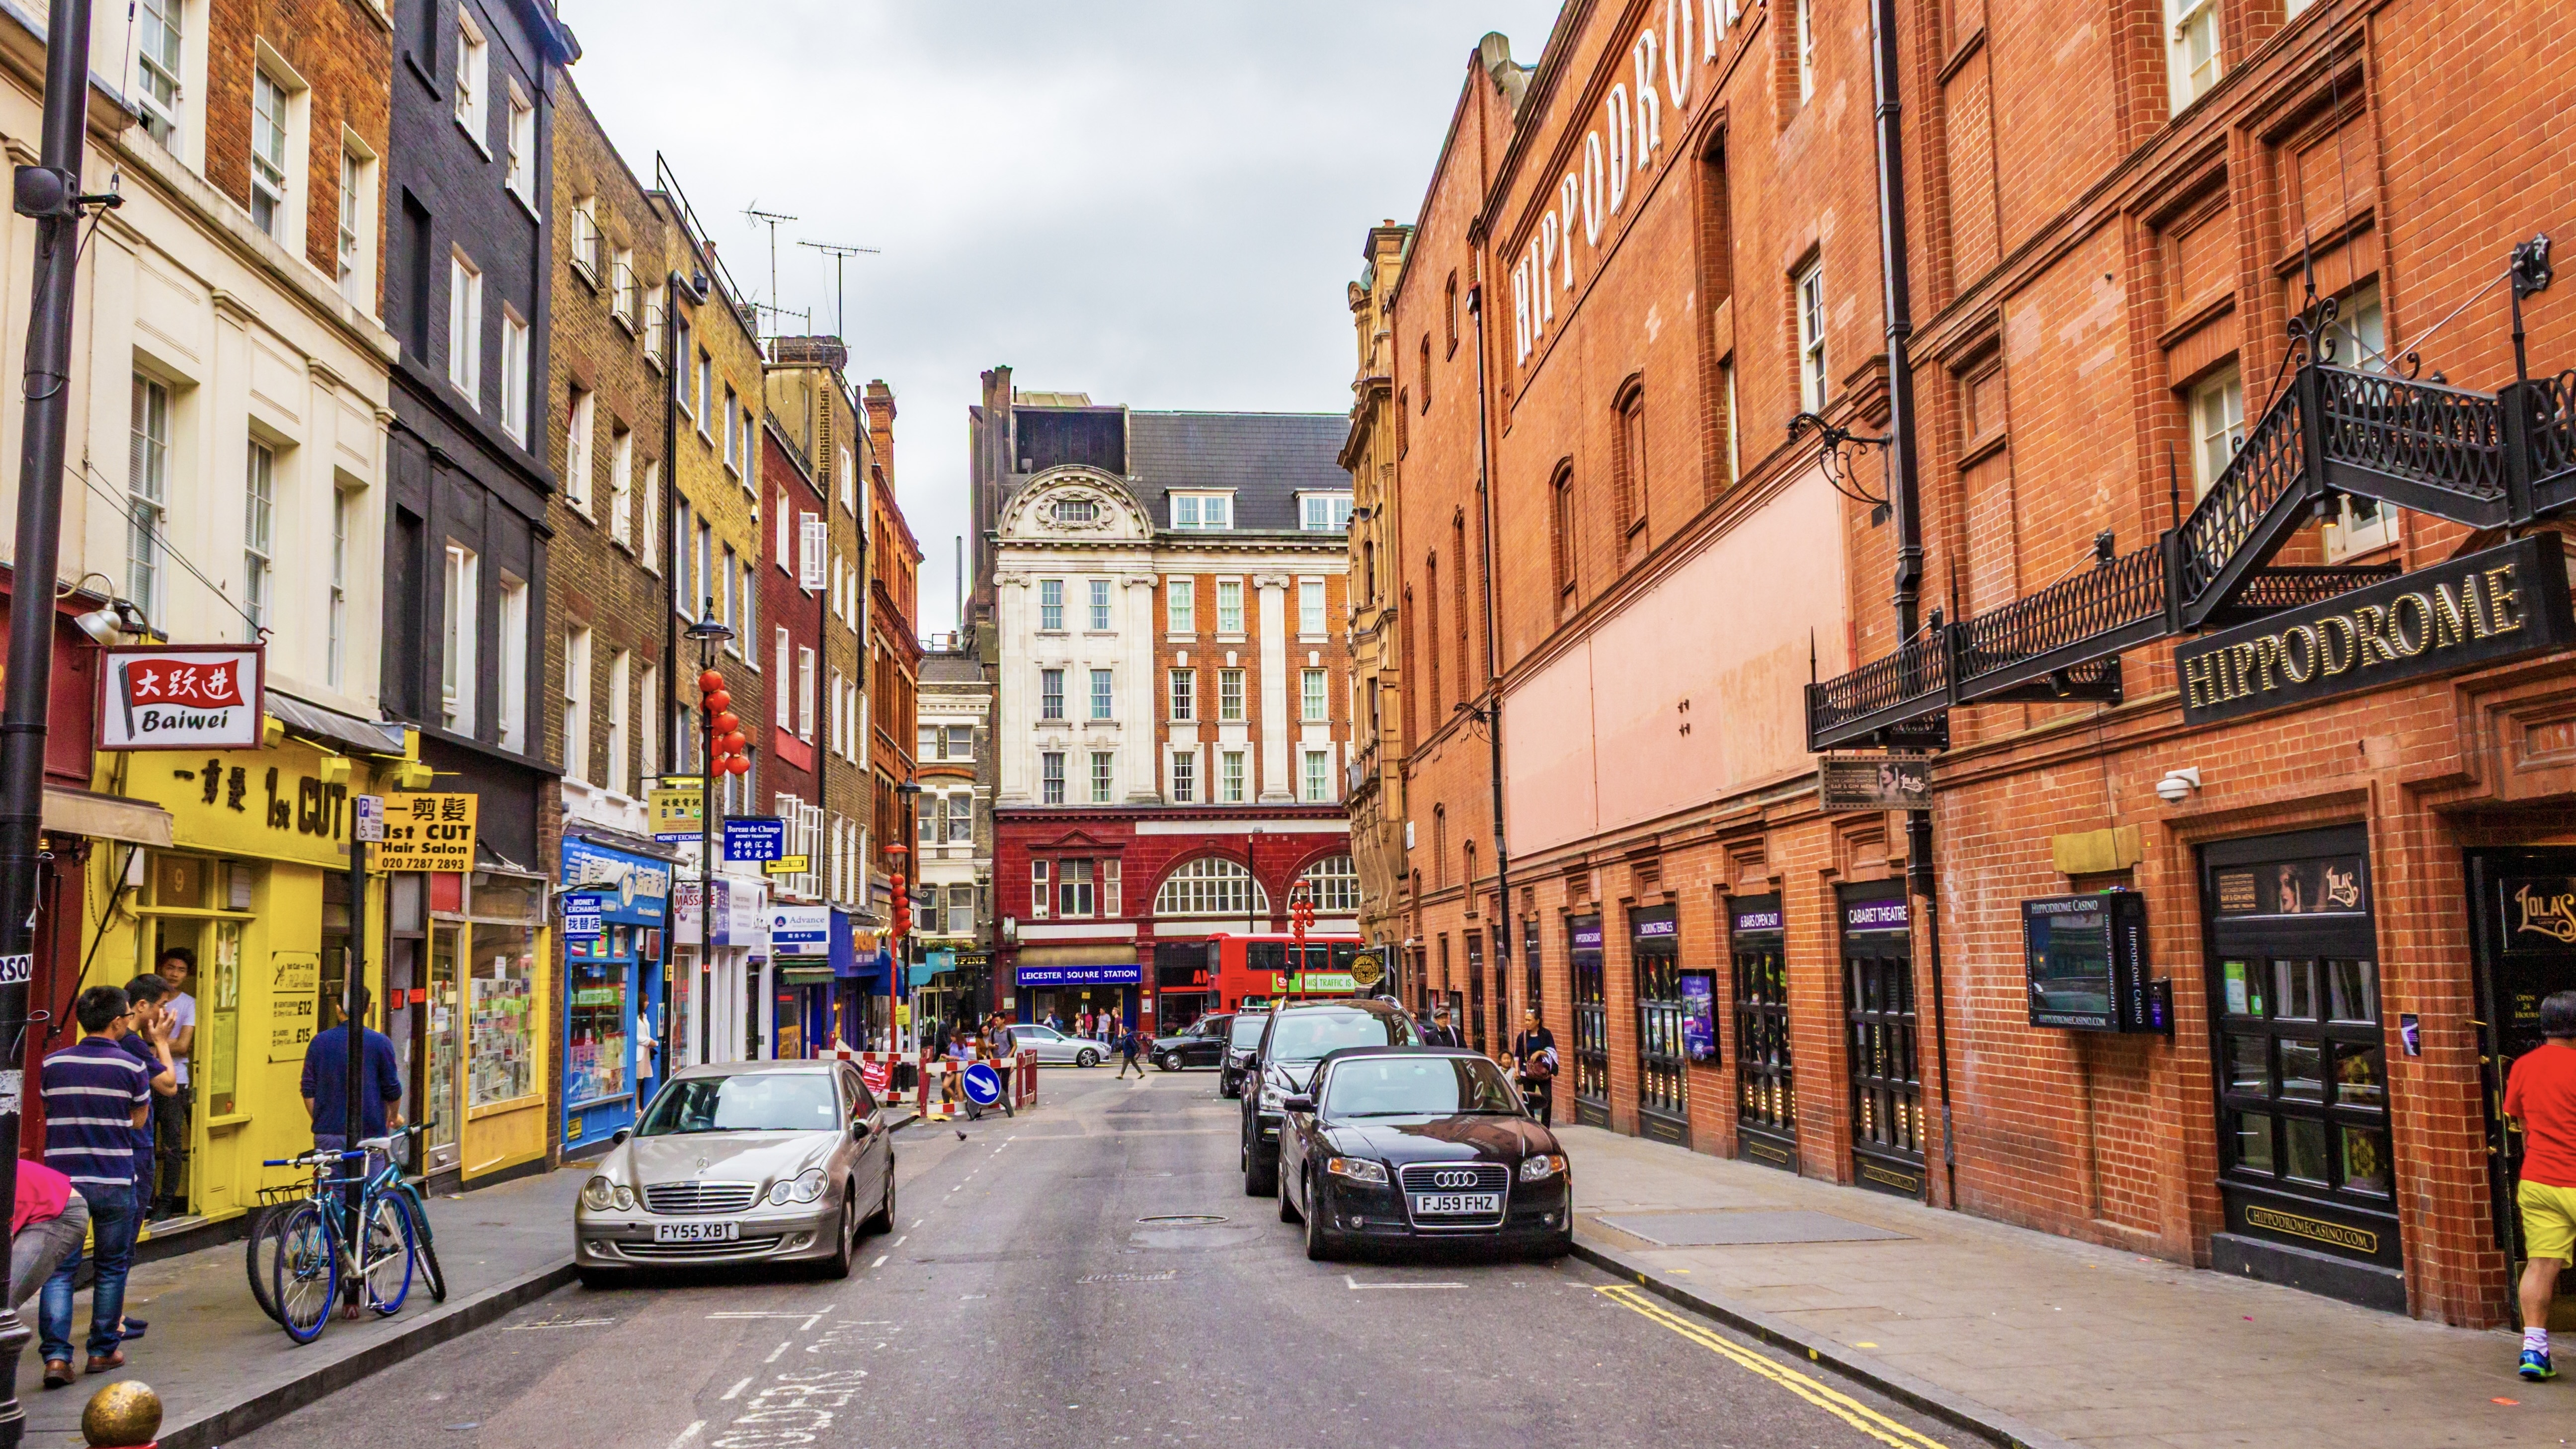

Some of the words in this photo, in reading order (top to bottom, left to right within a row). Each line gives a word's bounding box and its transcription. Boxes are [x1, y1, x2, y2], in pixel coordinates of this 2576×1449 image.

[2184, 564, 2523, 709] HIPPODROME
[136, 667, 233, 700] 大跃进
[142, 710, 228, 731] Baiwei
[298, 776, 346, 839] CUT
[361, 800, 368, 815] P
[384, 824, 414, 839] 1st
[426, 824, 471, 840] CUT
[758, 825, 781, 834] Change
[382, 842, 414, 853] Hair
[421, 843, 467, 854] Salon
[382, 858, 402, 868] 020
[406, 858, 433, 869] 7287
[438, 859, 464, 869] 2893
[175, 868, 184, 892] 9
[675, 894, 716, 906] MASSAE
[2031, 901, 2072, 914] HIPPODROME
[2073, 900, 2098, 911] CASINO
[1740, 917, 1743, 927] 6
[1744, 916, 1755, 927] BARS
[1755, 914, 1768, 926] OPEN
[1849, 908, 1877, 924] CABARET
[1877, 905, 1907, 922] THEATRE
[955, 956, 986, 965] UPINE
[2129, 927, 2140, 987] HIPPODROME
[1305, 978, 1316, 987] HIS
[1319, 978, 1343, 987] TRAFFIC
[1346, 978, 1352, 987] IS
[298, 1000, 312, 1015] £12
[2134, 989, 2143, 1024] CASINO
[2039, 1014, 2106, 1026] HIPPODROMECASINO.COM
[297, 1028, 310, 1043] £15
[1423, 1197, 1460, 1210] FJ59
[1465, 1196, 1493, 1210] FHZ
[661, 1224, 699, 1238] FY55
[704, 1223, 732, 1237] XBT
[2253, 1210, 2368, 1248] HIPPODROMECASINO.COM
